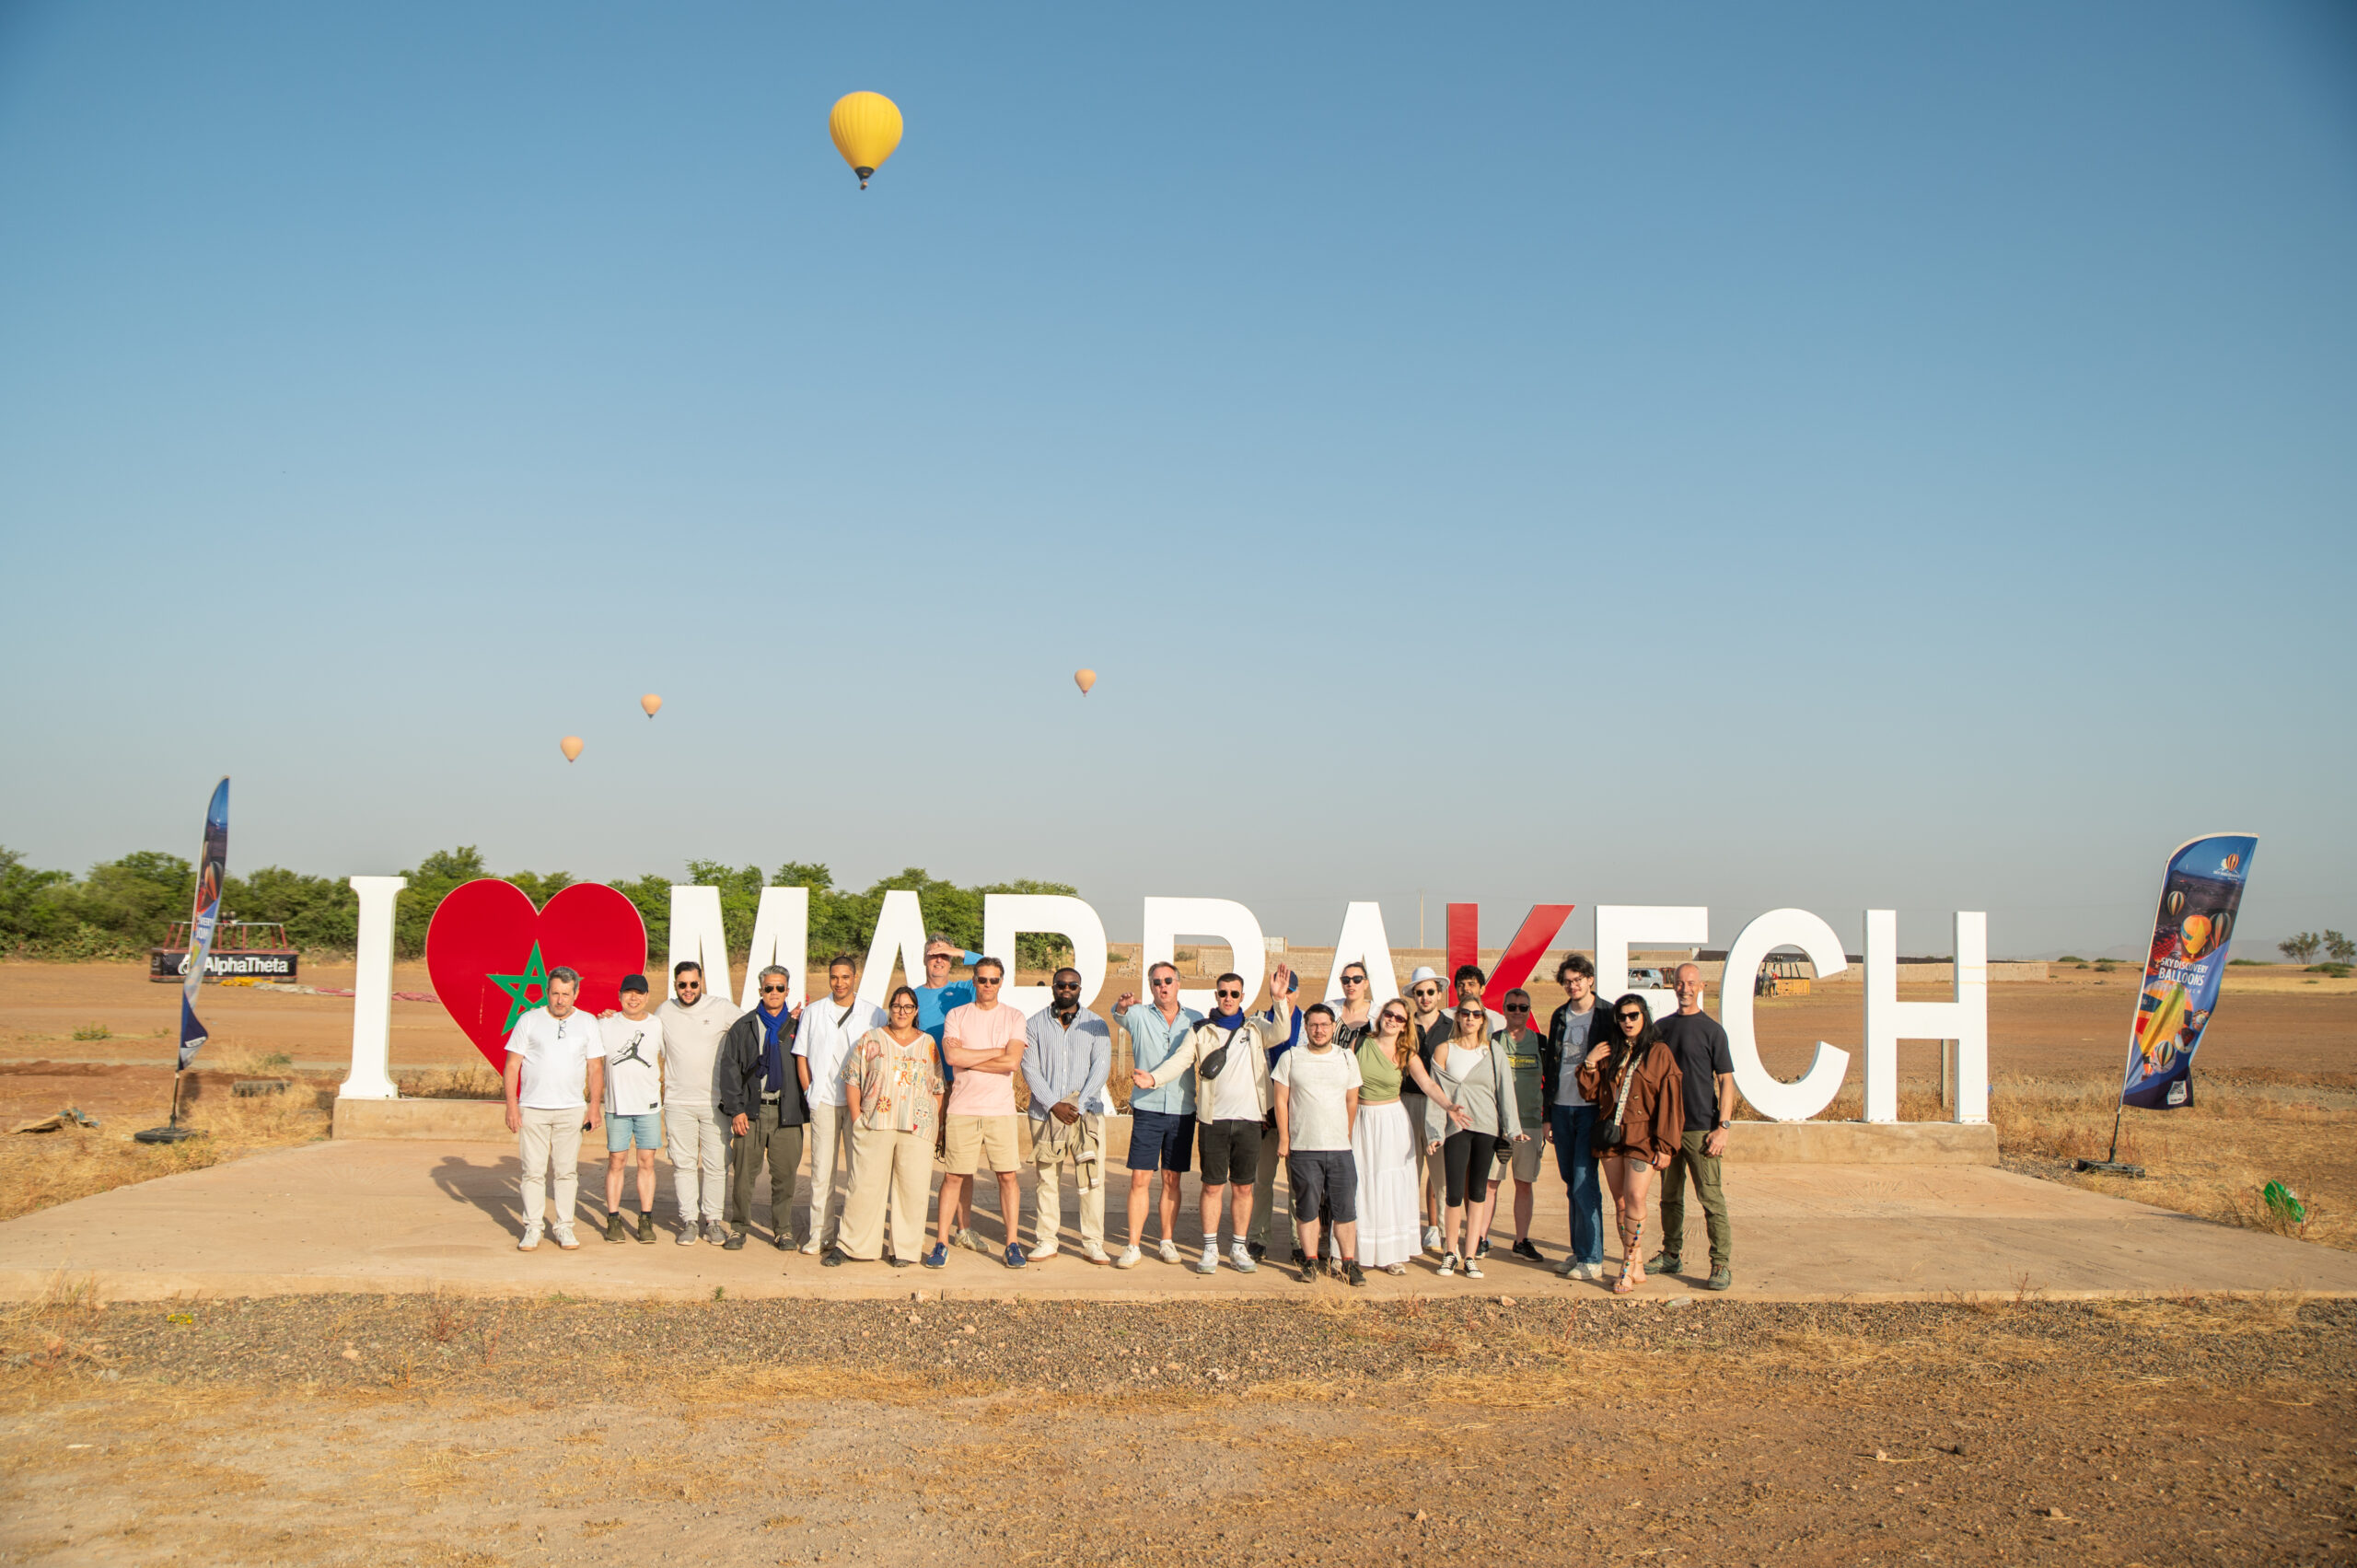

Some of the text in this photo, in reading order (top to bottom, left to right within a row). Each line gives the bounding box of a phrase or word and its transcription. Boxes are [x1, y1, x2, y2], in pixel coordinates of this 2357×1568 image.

[203, 957, 289, 976] AlphaTheta
[2161, 957, 2209, 974] SKY DISCOVERY
[2158, 967, 2205, 986] BALLOONS
[340, 876, 407, 1099] I
